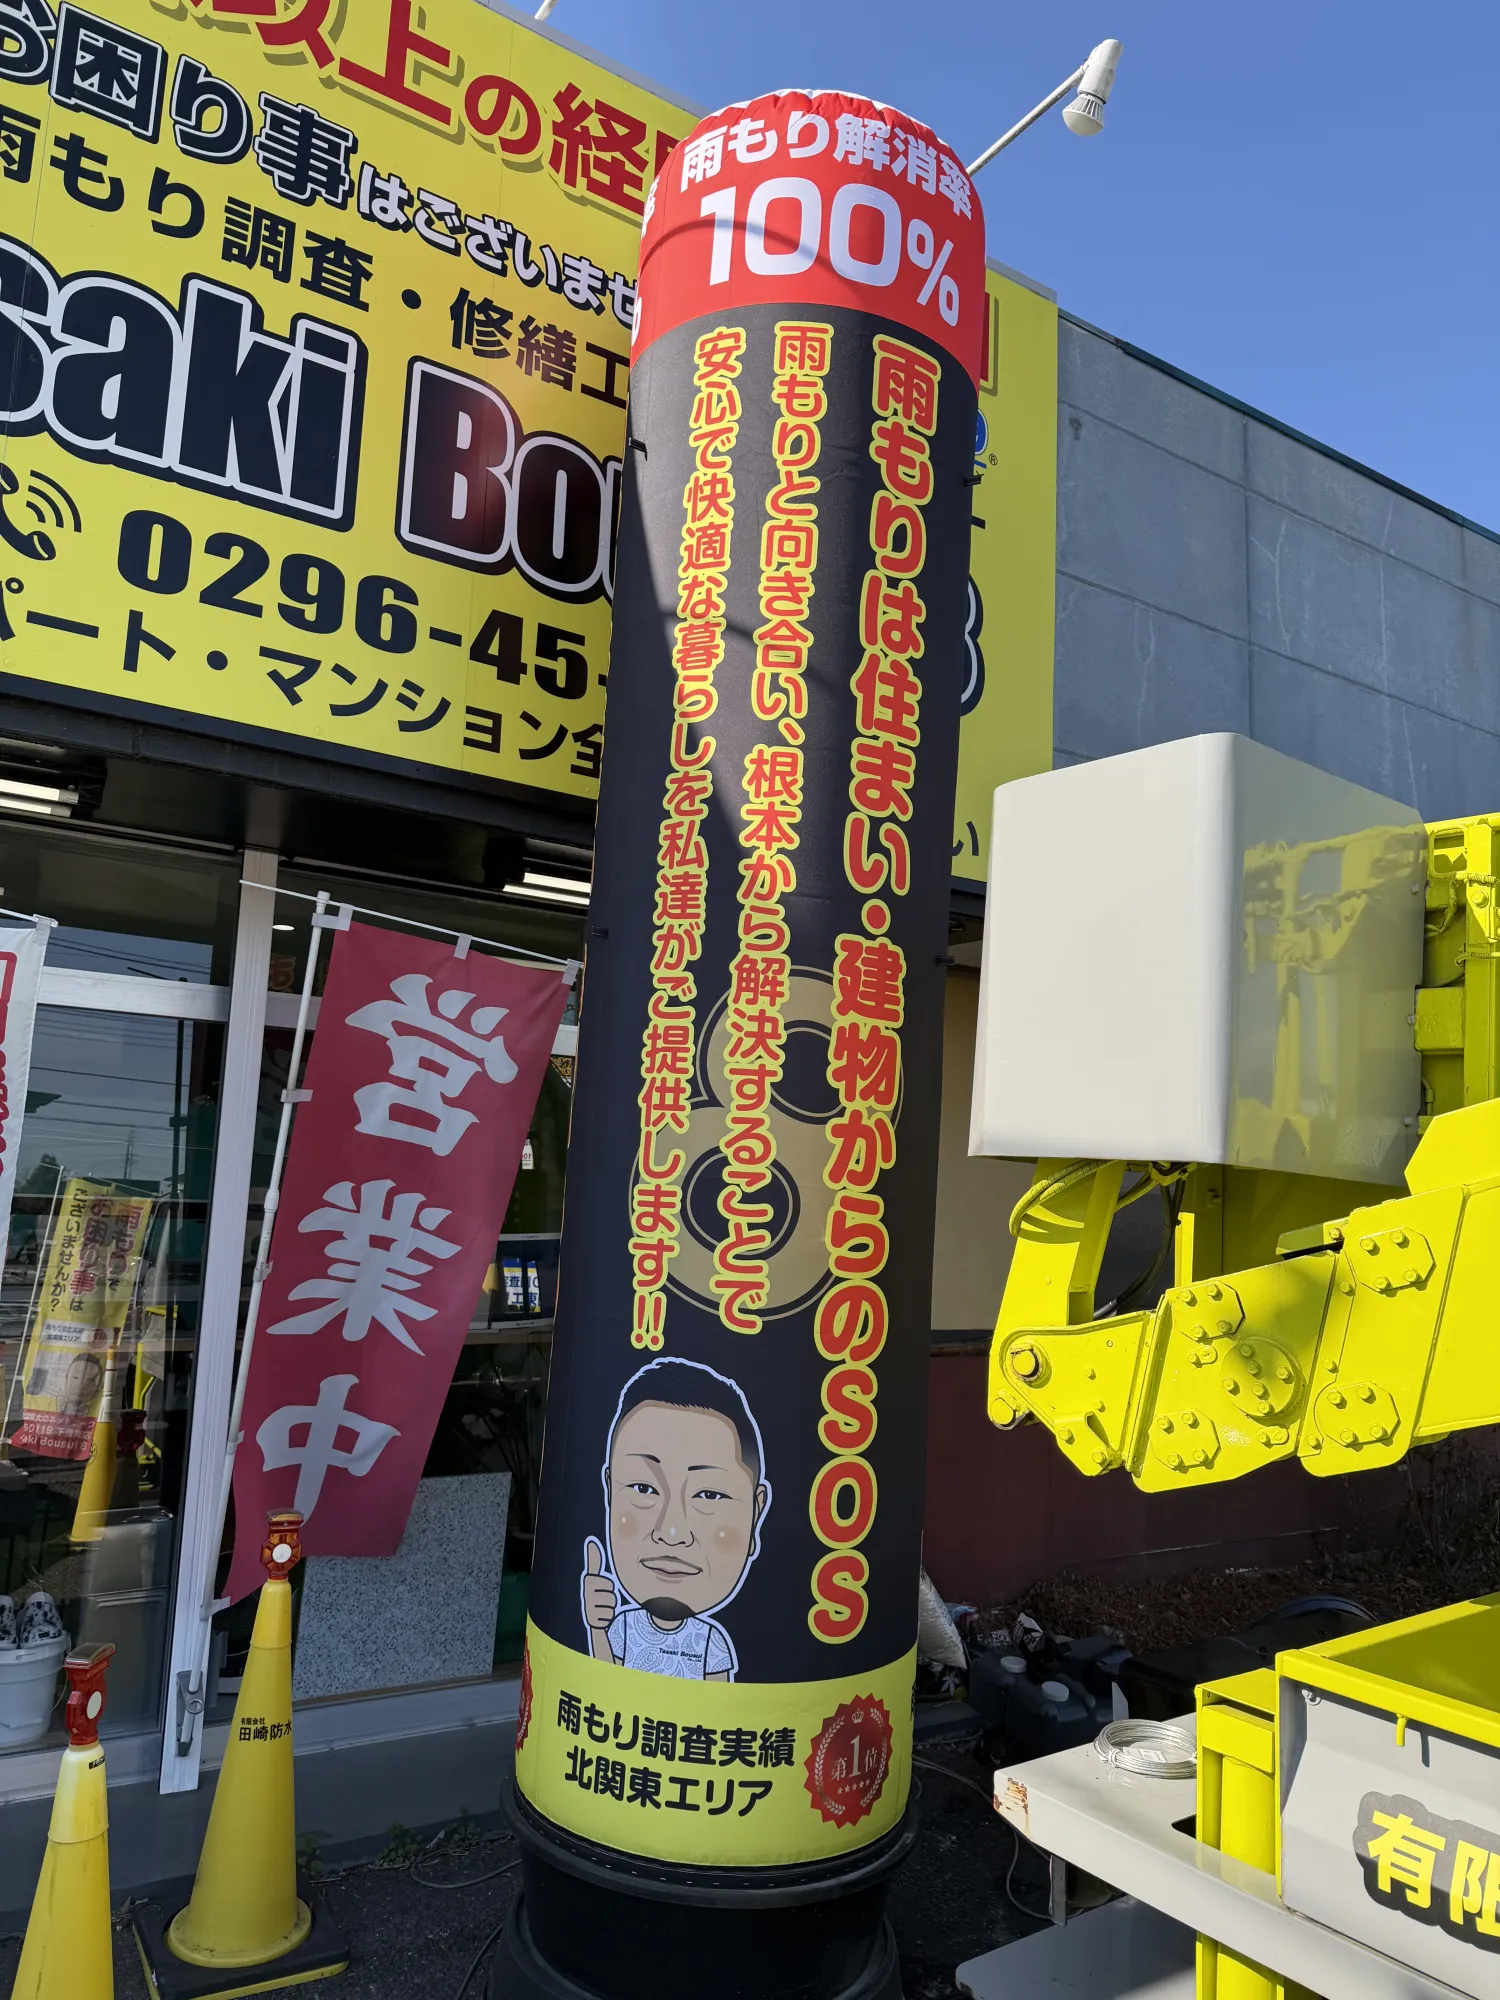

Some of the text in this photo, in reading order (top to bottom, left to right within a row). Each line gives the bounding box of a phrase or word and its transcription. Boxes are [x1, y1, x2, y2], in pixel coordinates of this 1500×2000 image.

[680, 111, 973, 220] 雨もり解消率
[700, 177, 960, 327] 100%
[395, 354, 628, 605] Bo
[118, 509, 607, 699] 0296-45
[711, 320, 834, 1334] 雨もりと向き合い、根本から解決することで
[266, 972, 518, 1527] 営業中
[239, 1719, 292, 1741] 田崎防水
[557, 1690, 796, 1769] 雨もり調査実績
[565, 1746, 774, 1818] 北関東エリア
